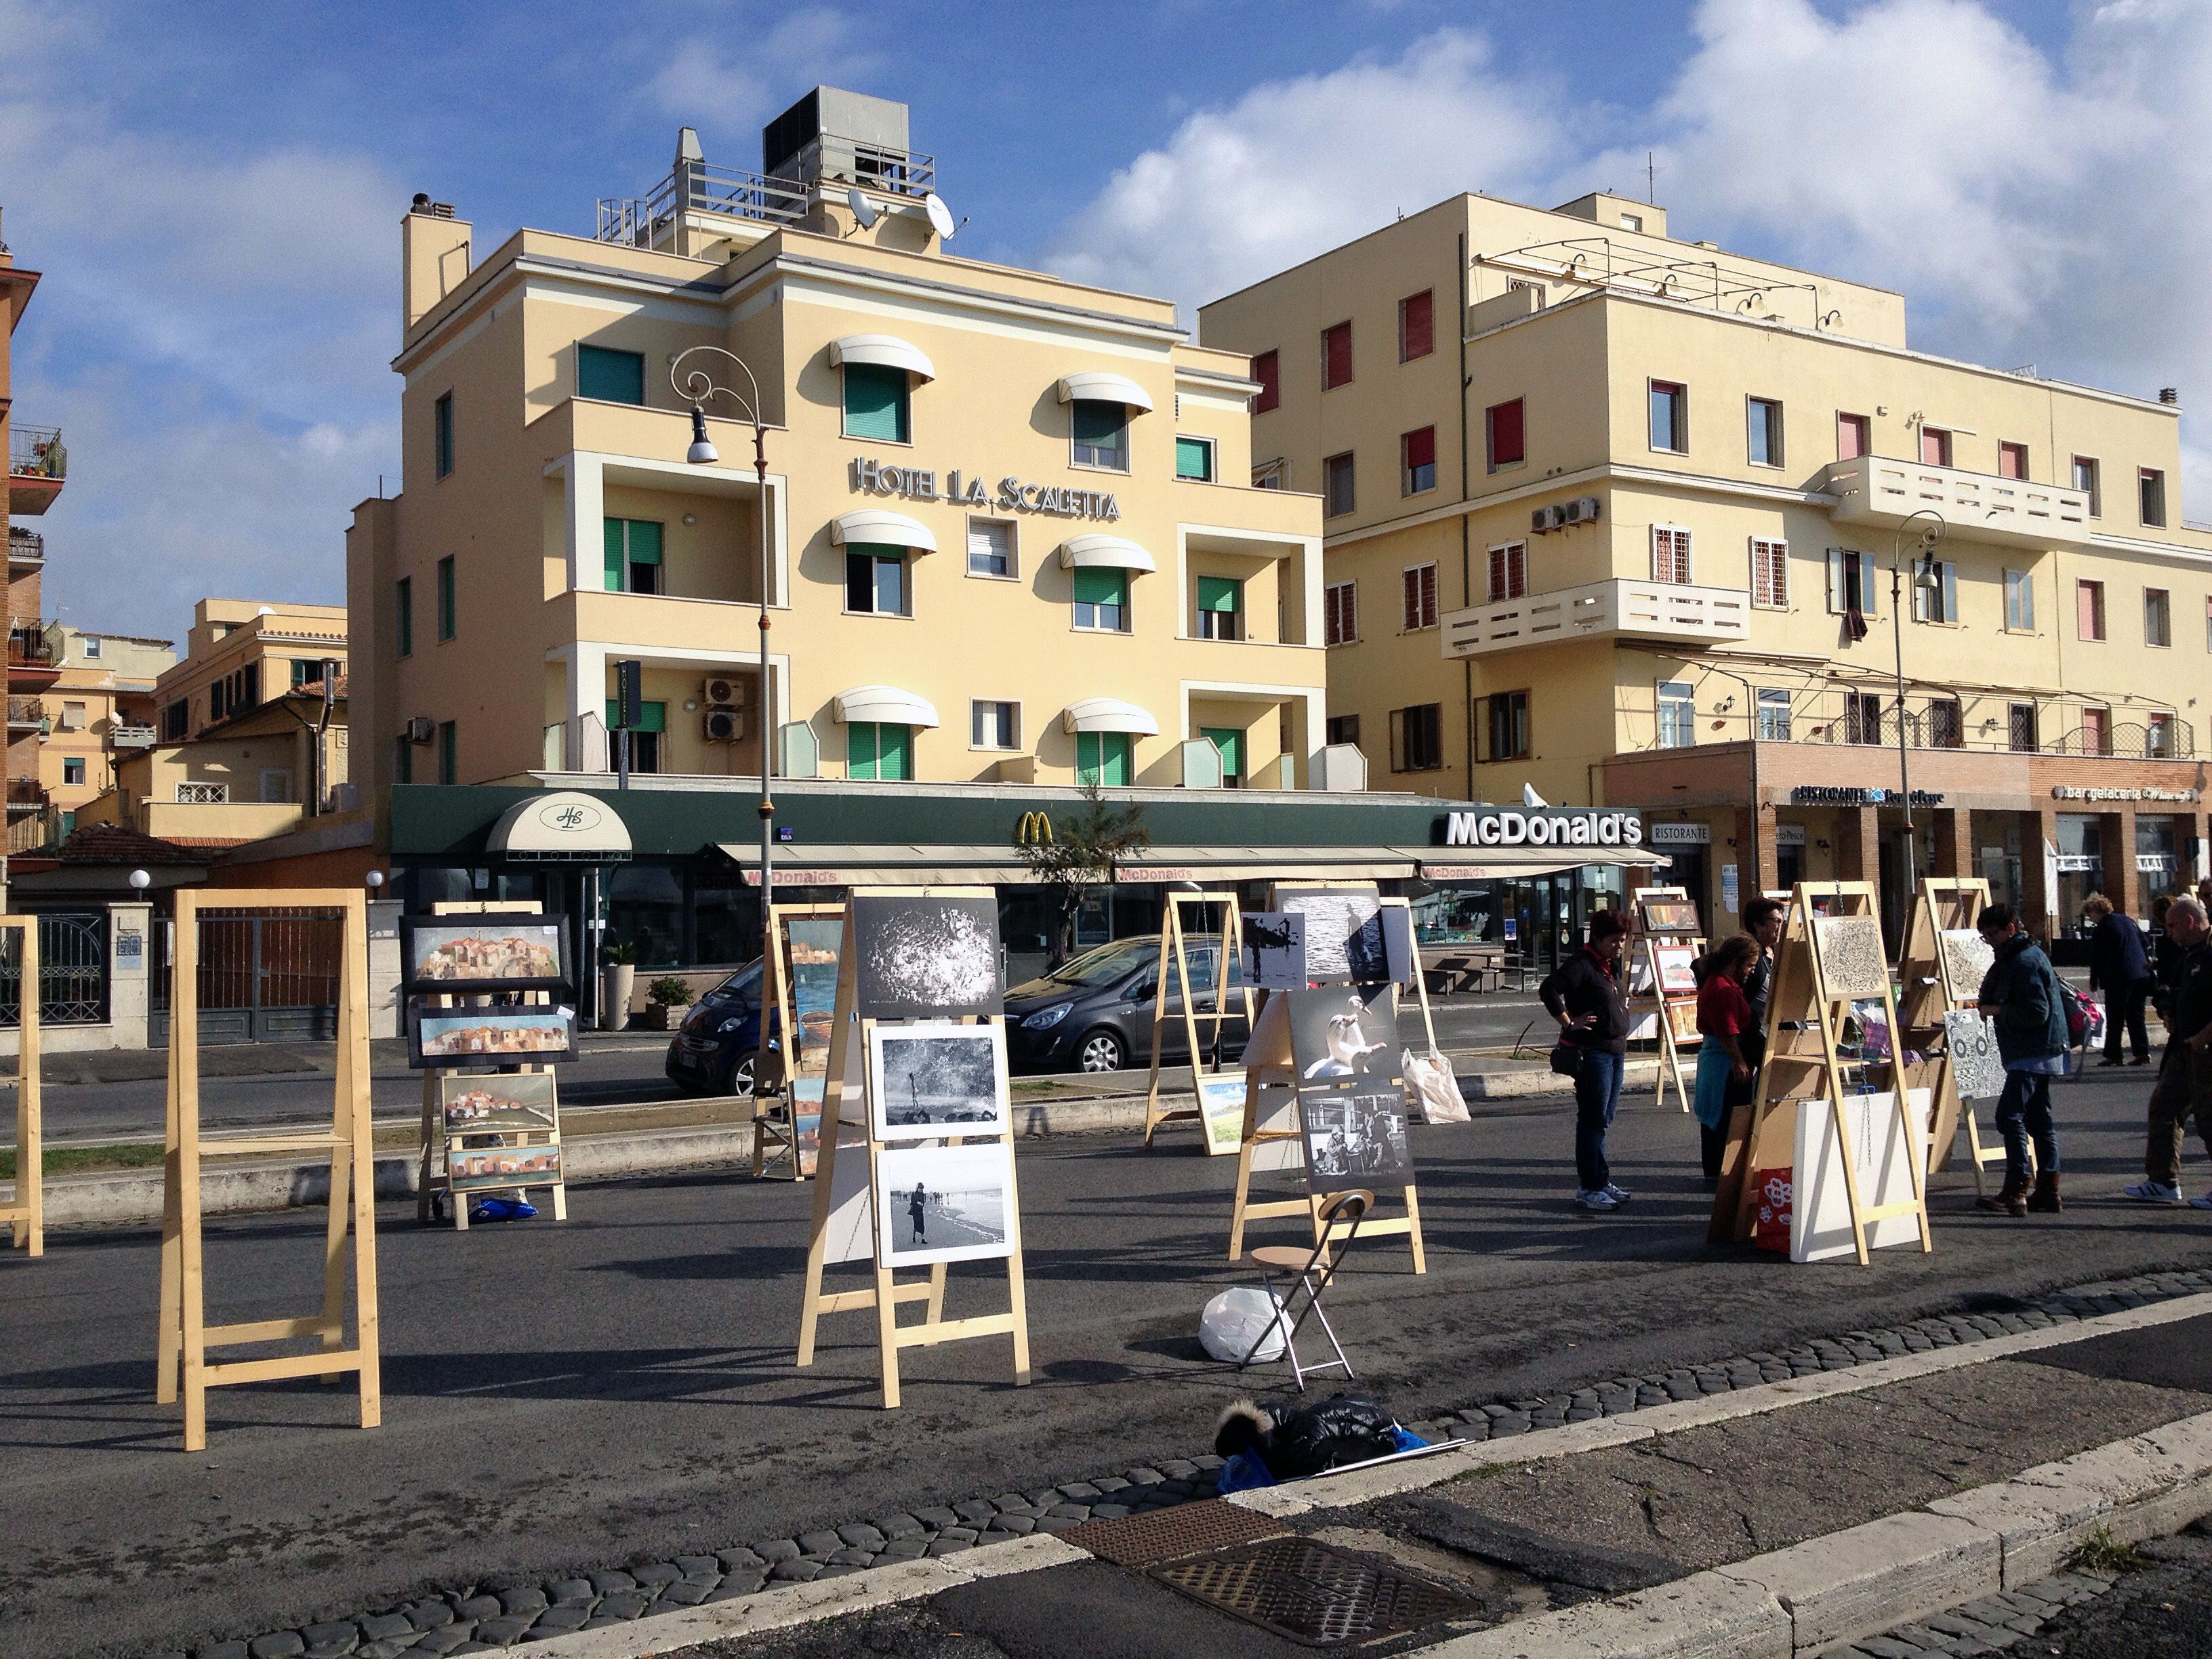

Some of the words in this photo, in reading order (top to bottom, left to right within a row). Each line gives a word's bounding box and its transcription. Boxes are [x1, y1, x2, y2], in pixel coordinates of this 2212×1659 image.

[954, 469, 990, 505] LA
[1003, 476, 1122, 520] SCALETTA
[1446, 812, 1642, 845] McDonald's
[1655, 827, 1708, 840] RISTORANTE
[747, 870, 838, 884] MDonald's
[1120, 868, 1193, 881] McDonald's
[1422, 867, 1486, 878] McDonald's
